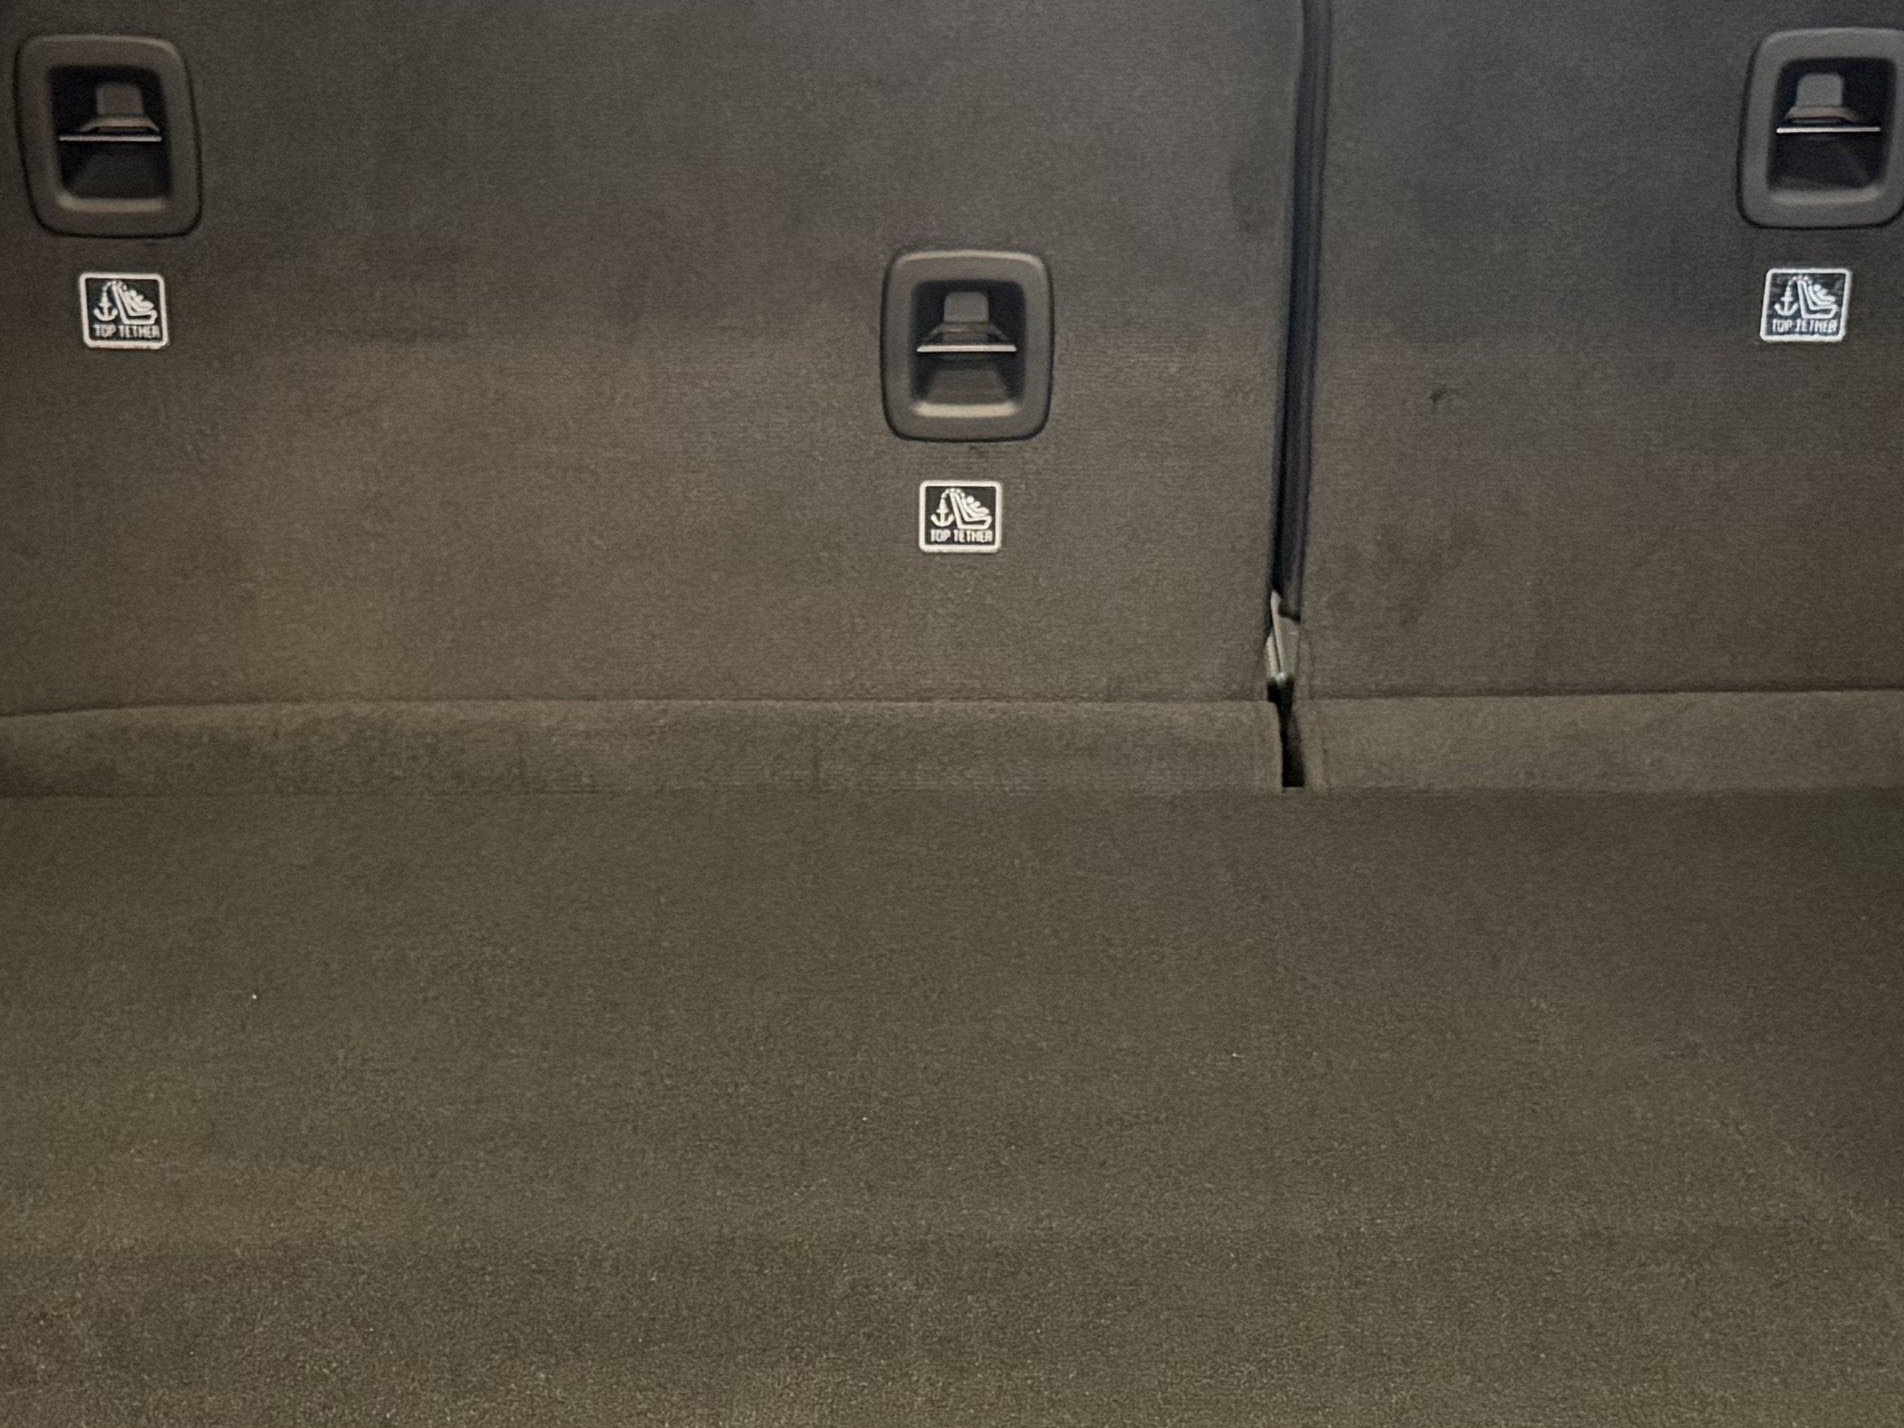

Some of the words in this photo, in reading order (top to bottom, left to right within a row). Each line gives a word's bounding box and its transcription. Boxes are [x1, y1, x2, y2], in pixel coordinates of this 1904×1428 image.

[92, 323, 117, 338] TOP
[117, 324, 161, 339] TETHER
[1771, 318, 1793, 333] TOP
[1794, 318, 1838, 334] TETHER
[929, 528, 952, 542] TOP
[953, 529, 994, 543] TETHER
